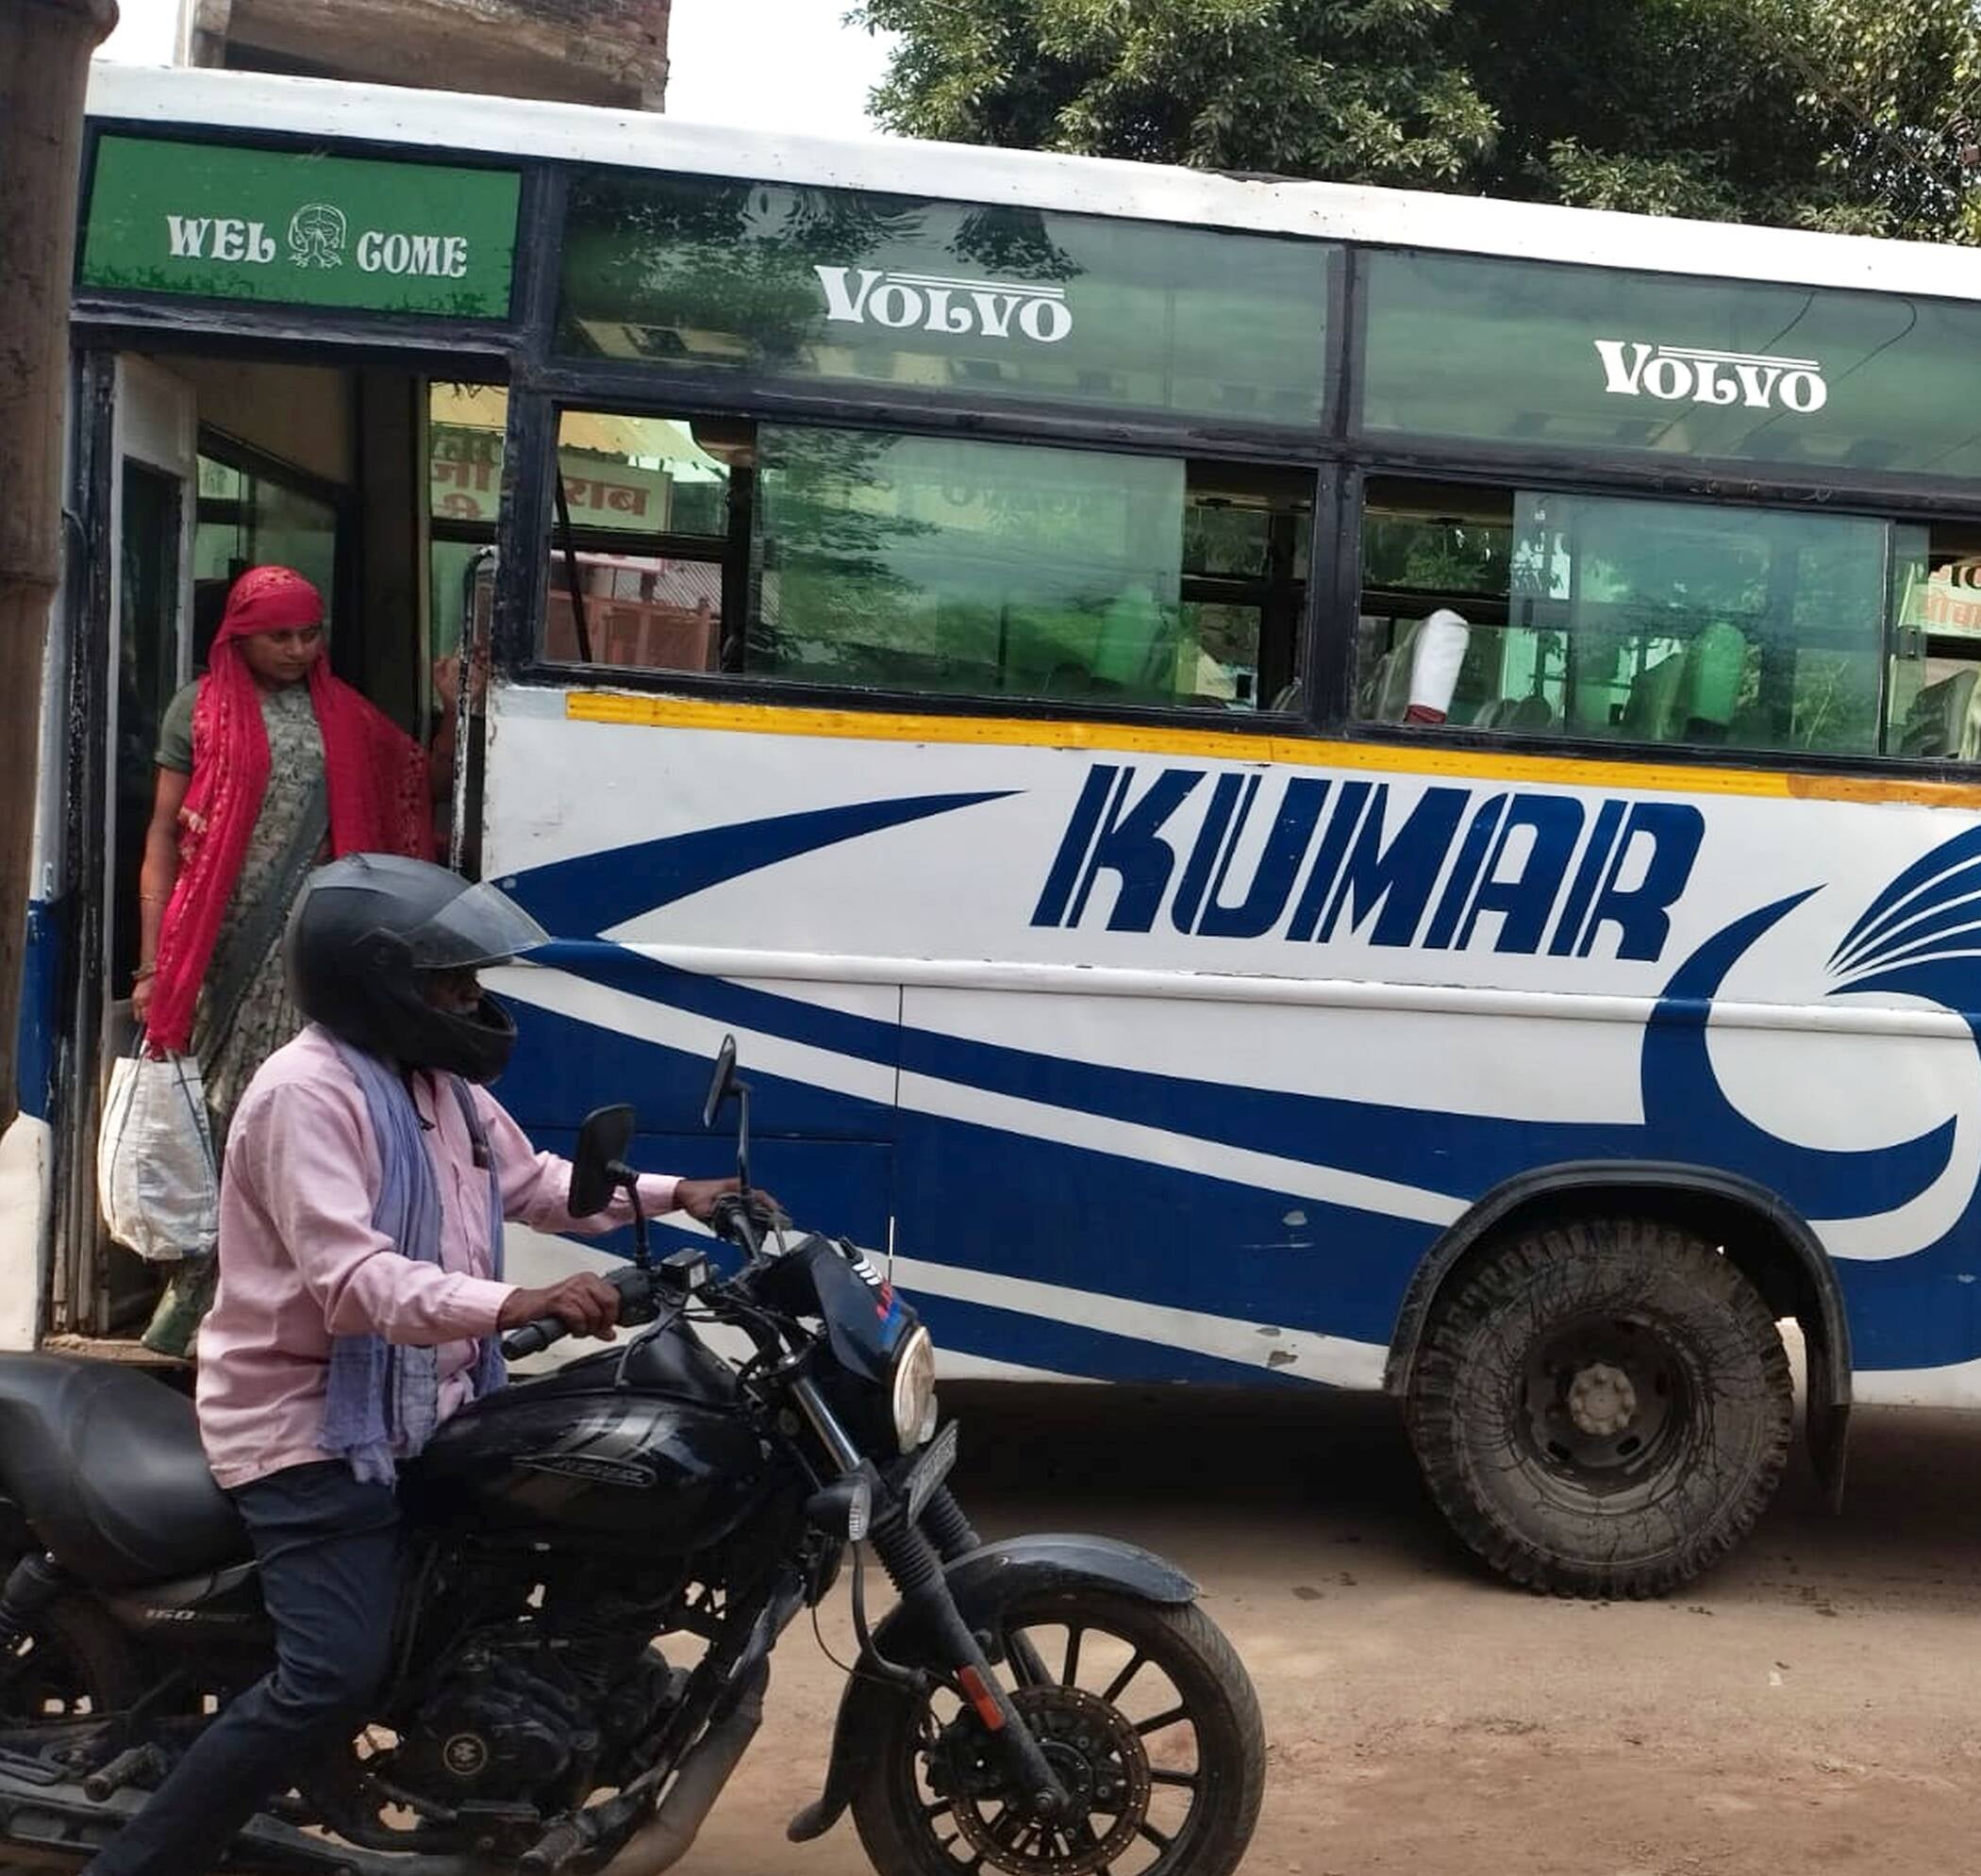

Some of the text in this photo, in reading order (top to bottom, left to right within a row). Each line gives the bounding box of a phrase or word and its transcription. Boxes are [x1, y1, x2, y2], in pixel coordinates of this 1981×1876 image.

[167, 215, 468, 278] WEL COME
[813, 265, 1073, 342] VOLVO
[1593, 340, 1827, 412] VOLVO
[1029, 763, 1706, 962] KUMAR
